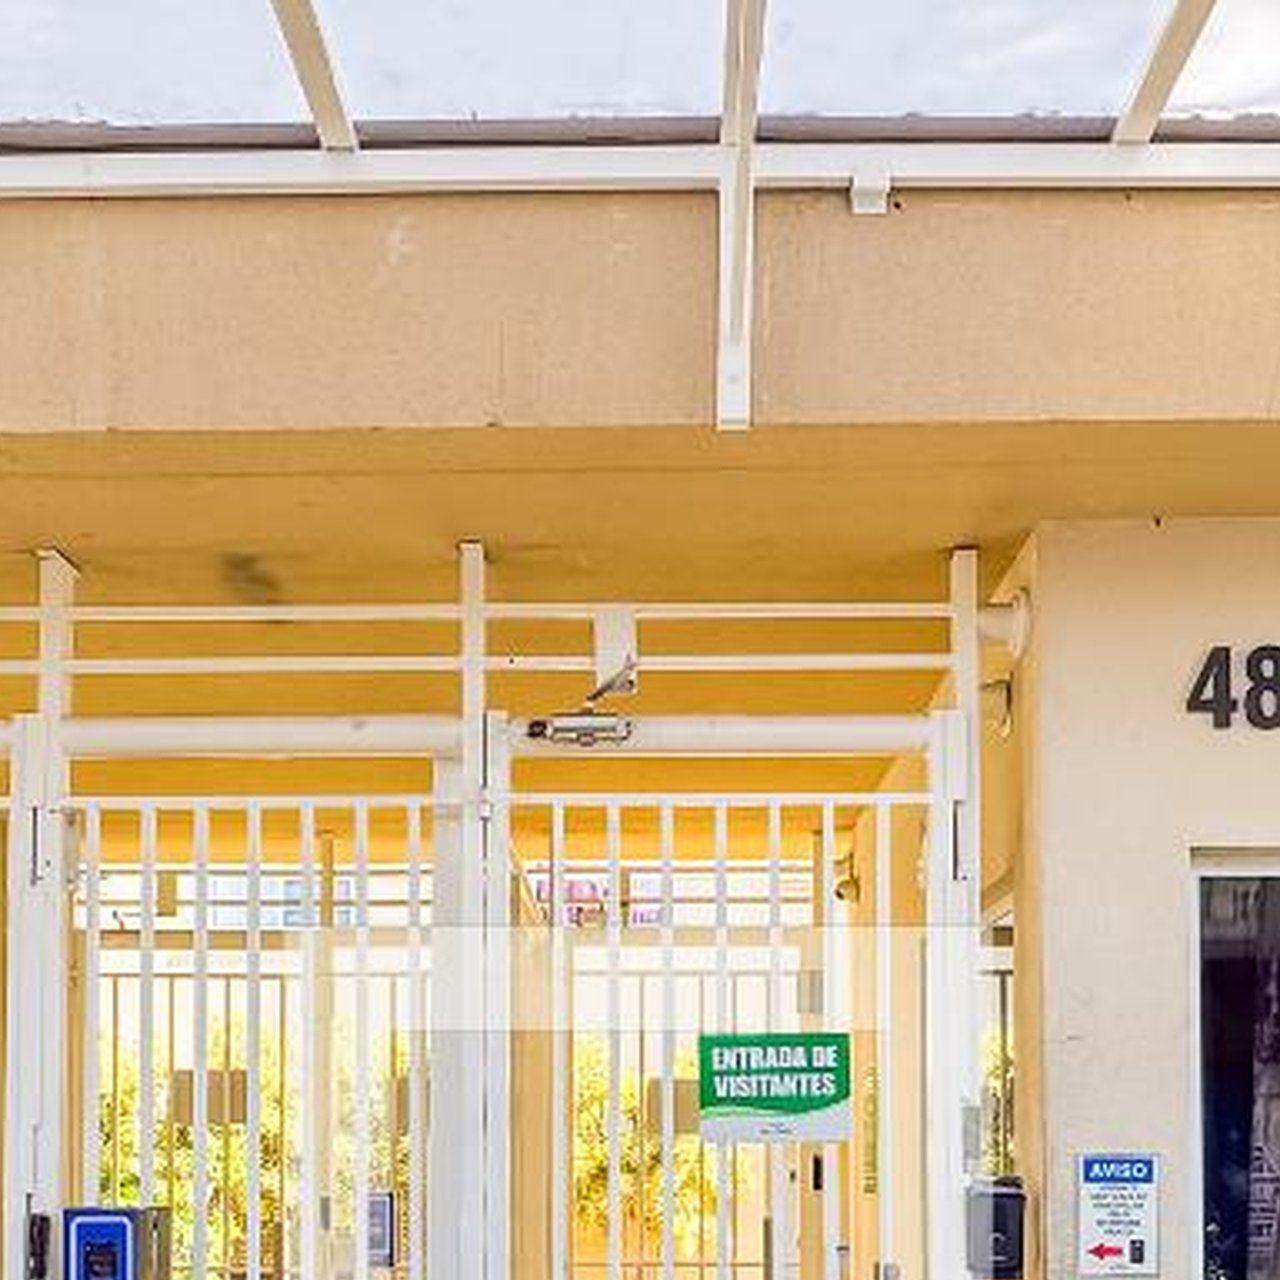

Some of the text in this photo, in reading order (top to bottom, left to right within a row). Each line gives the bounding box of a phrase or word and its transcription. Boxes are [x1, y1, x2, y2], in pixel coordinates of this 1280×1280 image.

[712, 1045, 839, 1070] ENTRADA DE
[713, 1073, 837, 1098] VISITANTES
[1088, 1161, 1148, 1179] AVISO
